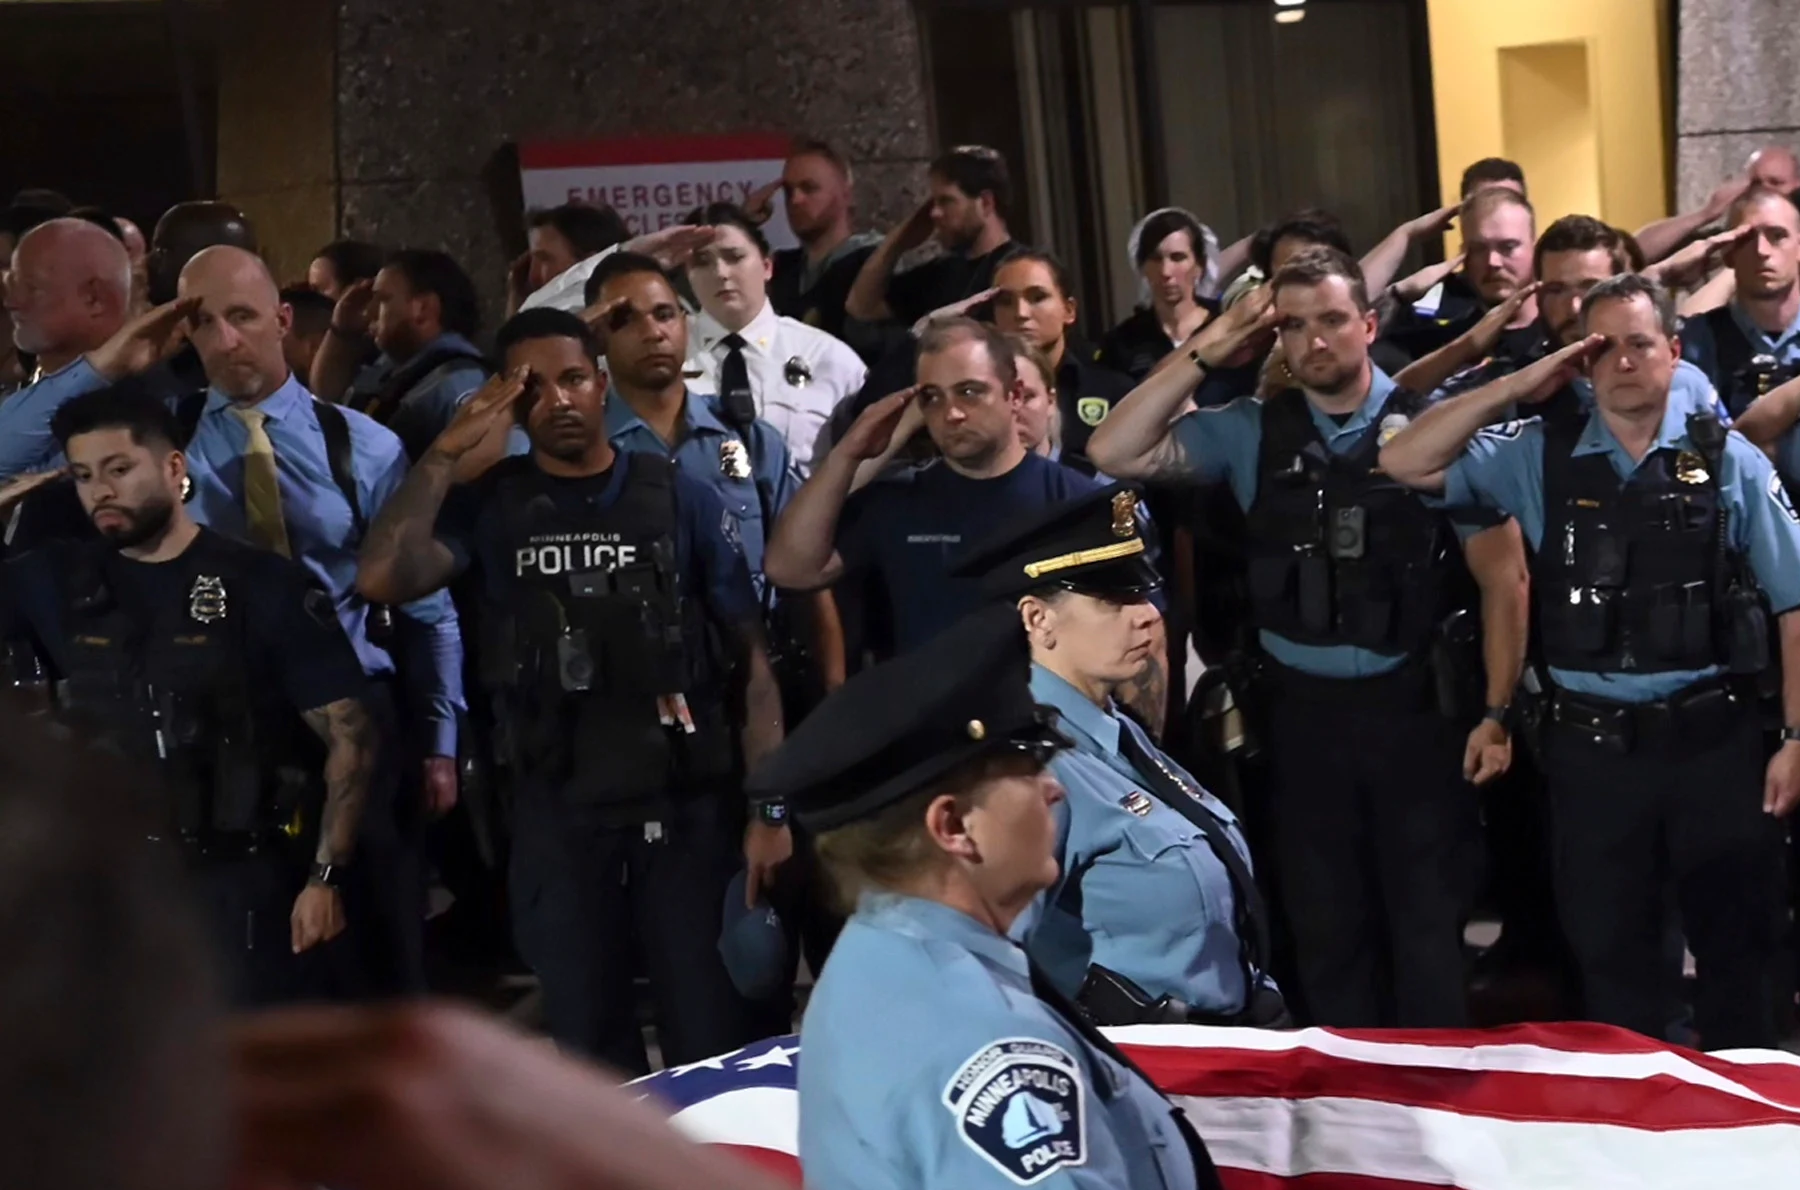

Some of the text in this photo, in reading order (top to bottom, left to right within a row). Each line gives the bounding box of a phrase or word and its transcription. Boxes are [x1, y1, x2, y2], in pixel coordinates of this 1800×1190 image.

[566, 179, 753, 210] EMERGENCY
[529, 532, 621, 543] MINNEAPOLIS
[516, 544, 636, 577] POLICE
[965, 1068, 1071, 1128] MINNEAPOLIS
[1020, 1140, 1076, 1173] POLICE
